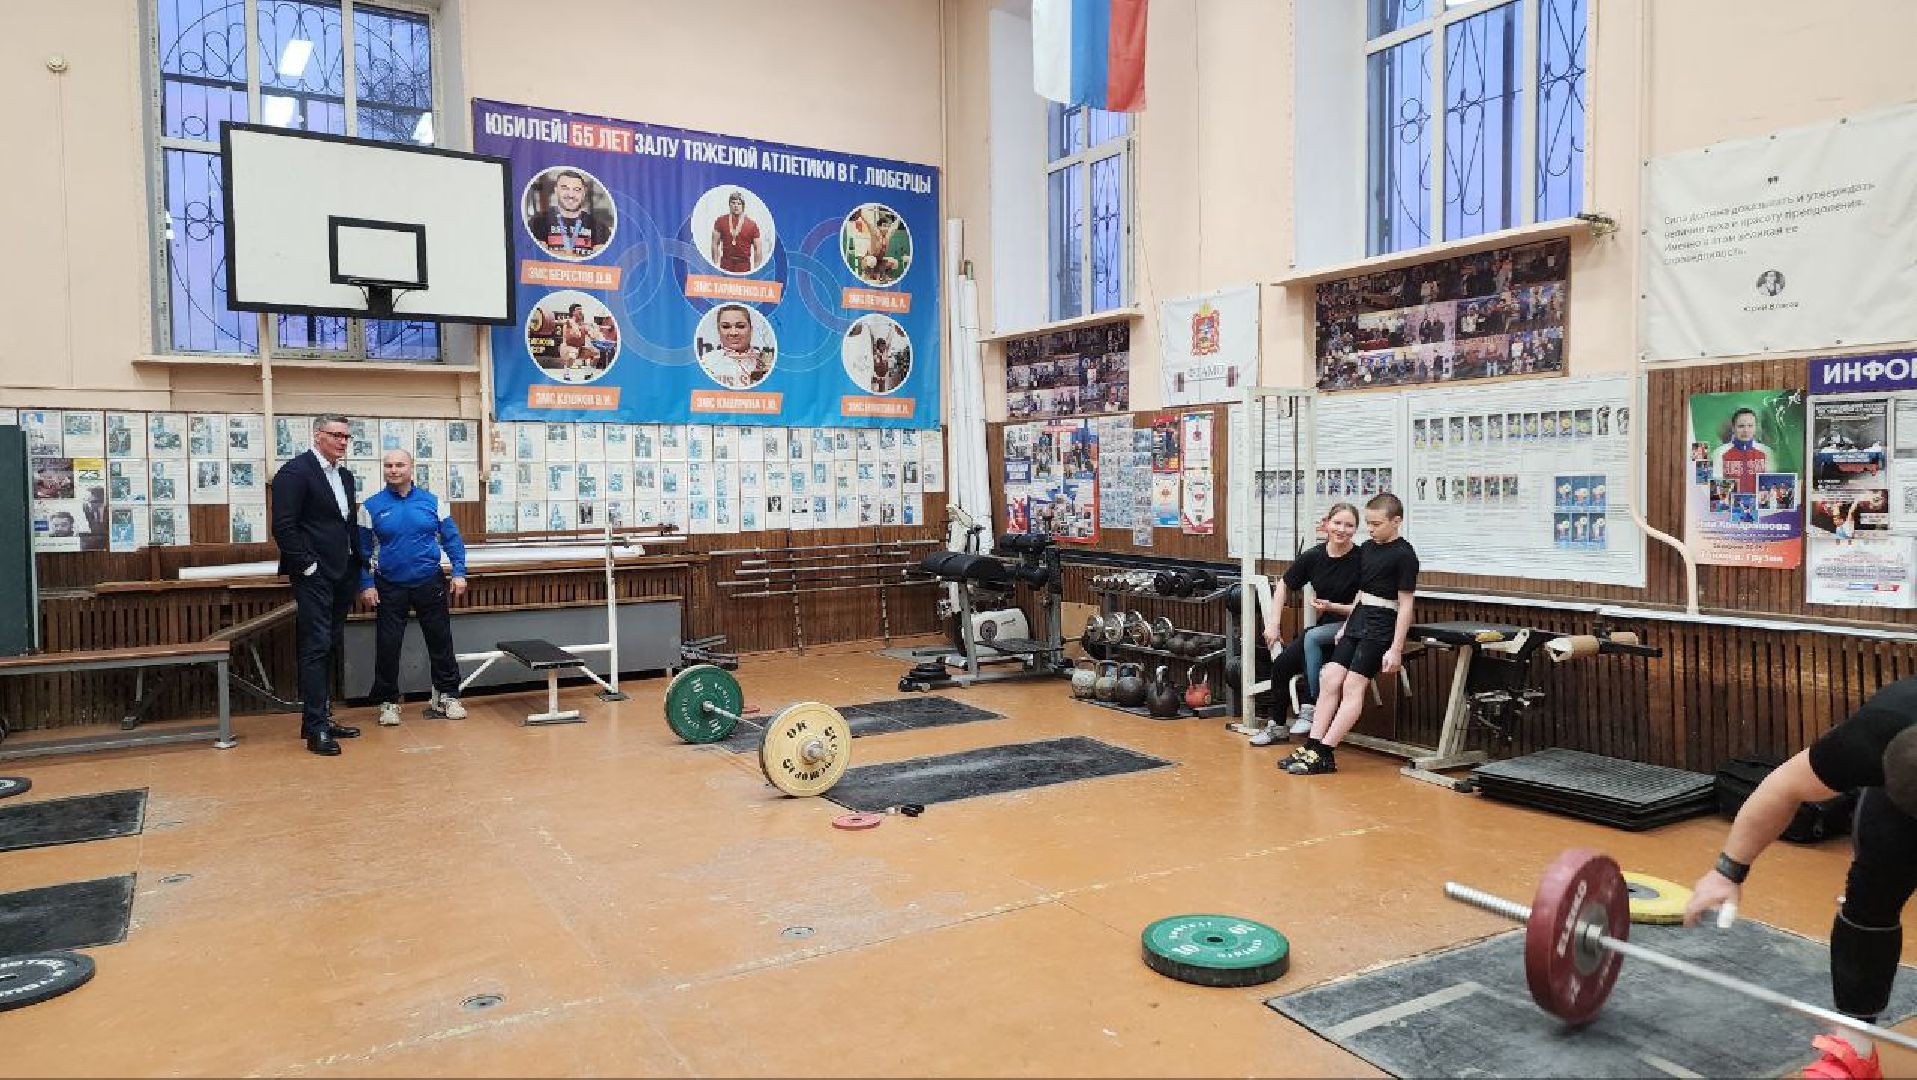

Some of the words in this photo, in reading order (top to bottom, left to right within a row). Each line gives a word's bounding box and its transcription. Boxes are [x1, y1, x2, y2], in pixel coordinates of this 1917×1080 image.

[485, 112, 568, 143] ЮБИЛЕЙ!
[572, 125, 594, 146] 55
[597, 127, 631, 152] ЛЕТ
[634, 133, 679, 158] ЗАЛУ
[682, 139, 757, 170] ТЯЖЕЛОЙ
[762, 151, 835, 180] АТЛЕТИКИ
[837, 163, 847, 181] В
[864, 167, 931, 194] ЛЮБЕРЦЫ
[1664, 216, 1688, 225] Сила
[1690, 208, 1729, 223] должна
[1741, 213, 1783, 227] красоту
[1665, 240, 1701, 252] Именно
